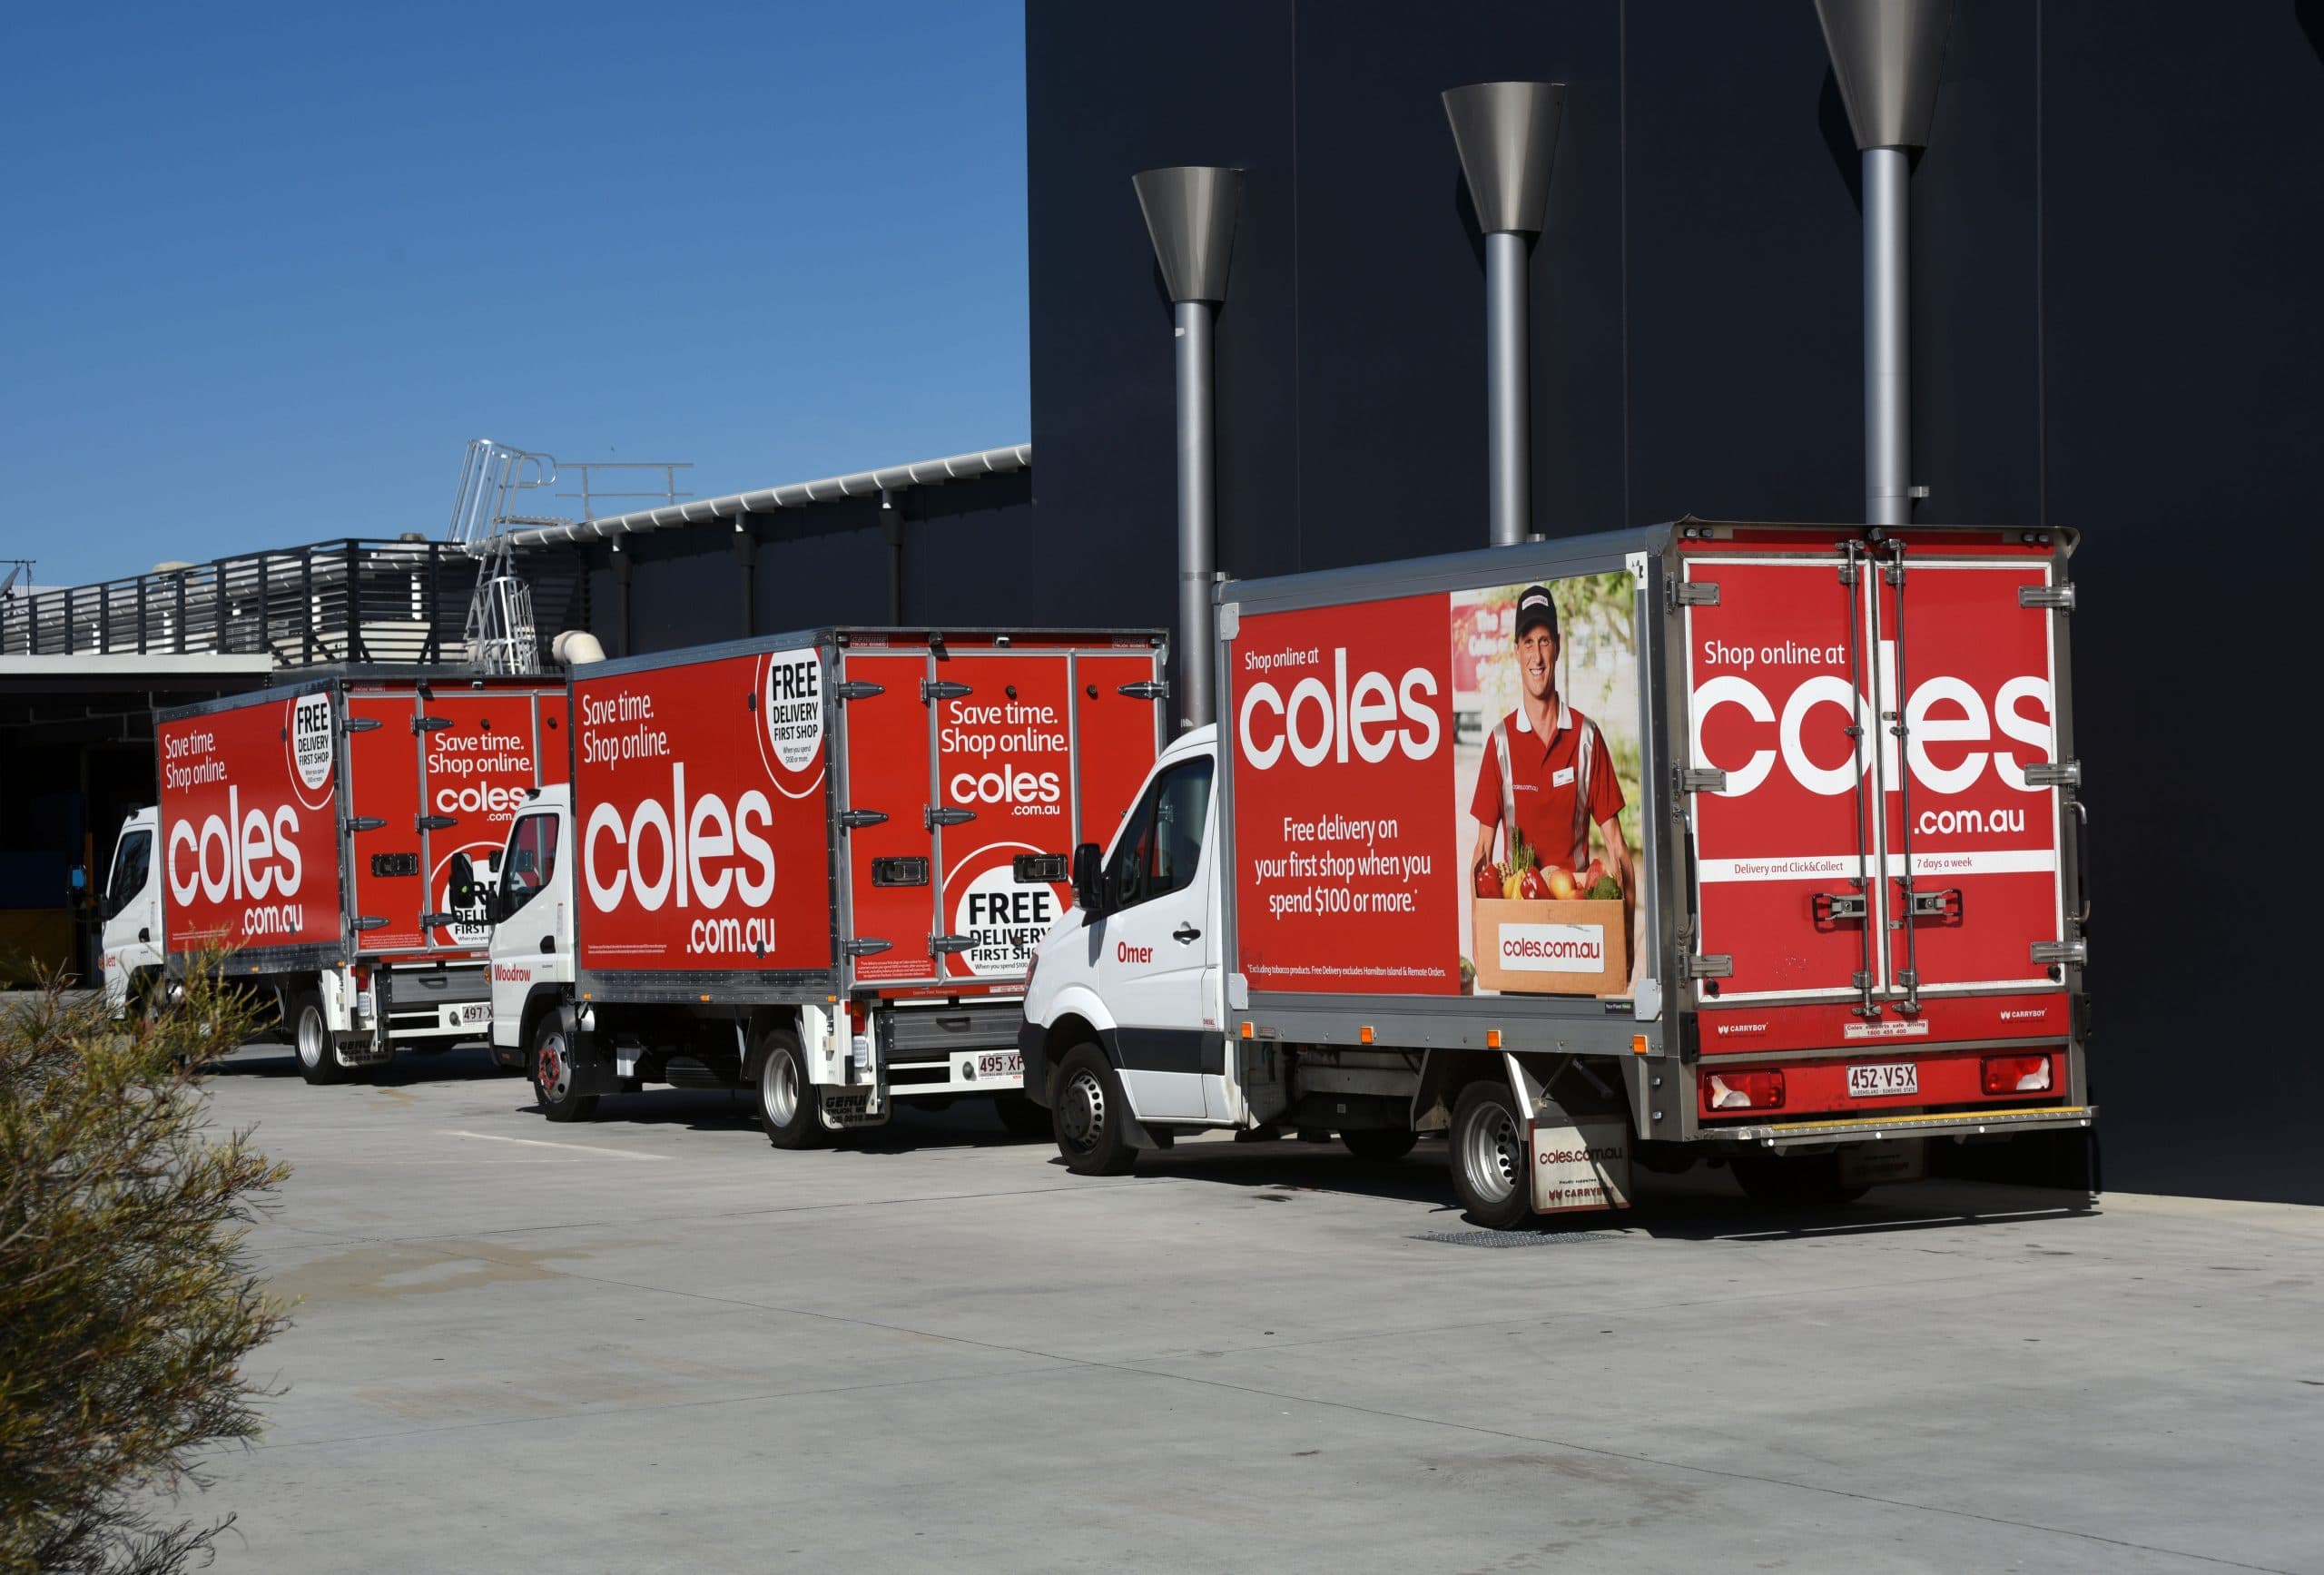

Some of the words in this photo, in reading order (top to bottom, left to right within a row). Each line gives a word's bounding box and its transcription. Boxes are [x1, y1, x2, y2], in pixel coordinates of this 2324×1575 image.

[1245, 650, 1271, 674] Shop
[1273, 647, 1305, 668] online
[1307, 647, 1319, 664] at
[1704, 640, 1755, 671] Shop
[1760, 640, 1821, 664] online
[1826, 644, 1846, 664] at
[772, 661, 818, 701] FREE
[297, 703, 329, 734] FREE
[583, 694, 615, 726] Save
[618, 690, 654, 722] time.
[773, 702, 818, 724] DELIVERY
[950, 701, 1002, 724] Save
[1005, 701, 1058, 724] time.
[1239, 647, 1440, 771] coles
[1693, 640, 2052, 797] coles
[165, 733, 189, 759] Save
[190, 730, 216, 755] time.
[298, 734, 329, 753] DELIVERY
[435, 733, 478, 752] Save
[480, 733, 525, 751] time.
[774, 726, 794, 741] FIRST
[796, 724, 818, 740] SHOP
[941, 727, 996, 760] Shop
[1000, 726, 1068, 753] online.
[299, 753, 313, 766] FIRST
[314, 751, 329, 763] SHOP
[584, 728, 619, 771] Shop
[622, 724, 670, 759] online.
[165, 761, 192, 793] Shop
[193, 755, 227, 784] online.
[428, 753, 473, 778] Shop
[477, 753, 534, 773] online.
[950, 763, 1060, 803] coles
[436, 781, 526, 812] coles
[487, 813, 514, 822] .com.
[1011, 805, 1060, 816] .com.au
[1914, 809, 2025, 835] .com.au
[584, 762, 775, 913] coles
[1284, 817, 1315, 842] Free
[1317, 813, 1375, 847] delivery
[1378, 819, 1398, 839] on
[169, 784, 302, 907] coles
[1255, 858, 1287, 885] your
[1289, 851, 1317, 878] first
[1320, 850, 1355, 884] shop
[1358, 849, 1400, 876] when
[1403, 855, 1431, 883] you
[1734, 863, 1769, 875] Delivery
[1771, 862, 1787, 872] and
[1789, 861, 1844, 872] Click&Collect
[1917, 859, 1922, 868] 7
[1923, 858, 1943, 871] days
[1944, 860, 1949, 868] a
[1951, 857, 1973, 867] week
[969, 891, 1050, 925] FREE
[1269, 886, 1312, 920] spend
[1315, 886, 1350, 916] $100
[1354, 893, 1369, 912] or
[241, 904, 303, 936] .com.au
[455, 924, 485, 934] FIRST
[686, 918, 775, 954] .com.au
[1503, 938, 1600, 959] coles.com.au
[970, 948, 1009, 961] FIRST
[1118, 941, 1153, 963] Omer
[494, 964, 530, 981] Woodrow
[1000, 962, 1016, 970] spend
[1272, 964, 1289, 974] tobacco
[1289, 966, 1311, 976] products.
[1312, 966, 1322, 975] Free
[1323, 966, 1342, 977] Delivery
[1343, 966, 1363, 975] excludes
[1363, 966, 1386, 976] Hamilton
[1387, 967, 1402, 976] Island
[1403, 967, 1407, 976] &
[1408, 967, 1427, 976] Remote
[2012, 1009, 2045, 1018] CARRYBOY
[1729, 1024, 1767, 1032] CARRYBOY
[1540, 1147, 1623, 1165] coles.com.au
